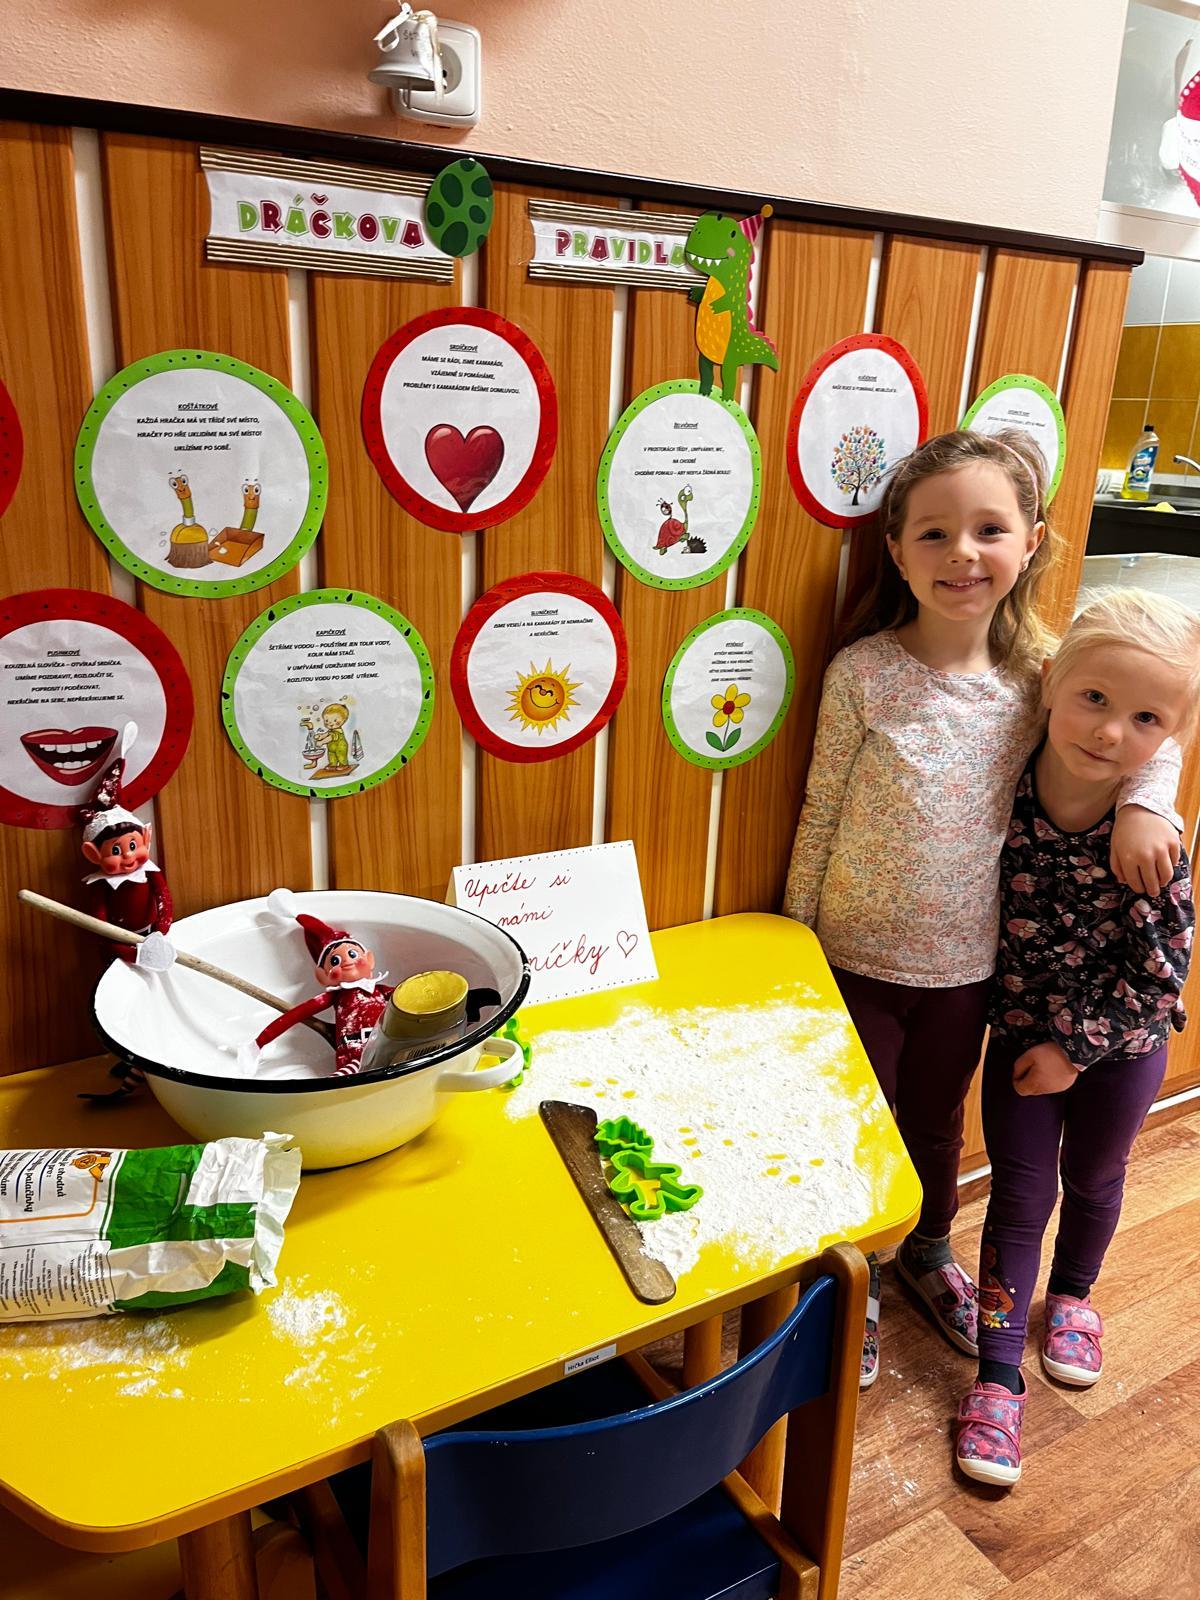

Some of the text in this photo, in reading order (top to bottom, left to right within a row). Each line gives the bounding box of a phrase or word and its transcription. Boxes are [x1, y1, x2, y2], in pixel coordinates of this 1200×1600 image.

[236, 193, 424, 249] DRÁČKOVA
[555, 228, 686, 268] PRAVIDLA
[187, 416, 197, 424] MÁ
[208, 416, 225, 424] TŘÍDĚ
[137, 430, 162, 438] HRAČKY
[316, 629, 346, 637] KAPIČKOVÉ
[320, 641, 347, 649] POUŠTÍME
[293, 663, 323, 671] UMÝVÁRNĚ
[356, 672, 379, 680] UTŘEME.
[465, 869, 572, 907] Upečte si
[496, 902, 553, 927] námi
[527, 934, 610, 975] níčky
[24, 1172, 34, 1212] palačinky
